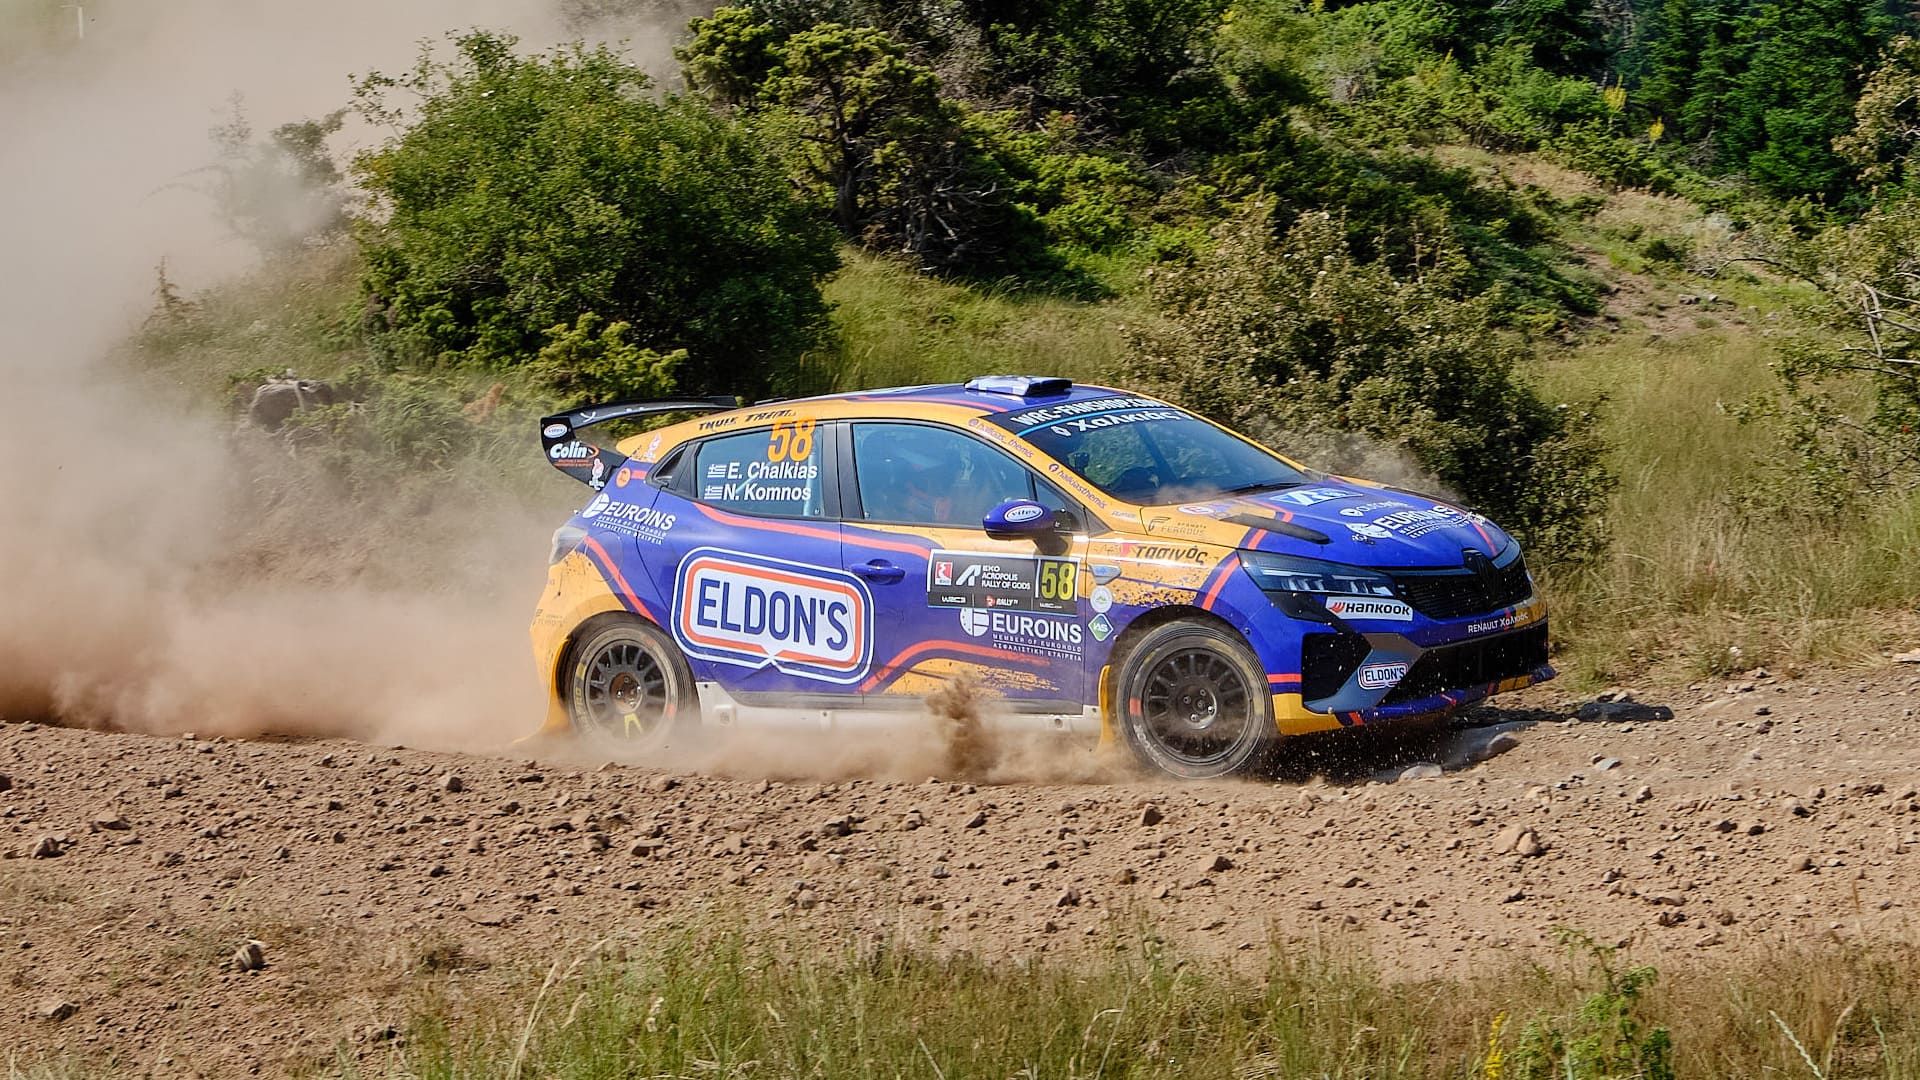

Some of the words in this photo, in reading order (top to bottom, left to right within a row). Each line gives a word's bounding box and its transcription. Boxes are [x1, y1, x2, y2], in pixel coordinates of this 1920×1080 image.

[767, 416, 816, 462] 58
[550, 441, 588, 459] Colin
[727, 462, 742, 479] E.
[747, 461, 818, 479] Chalkias
[723, 483, 739, 500] N.
[744, 483, 812, 500] Komnos
[602, 501, 676, 531] EUROINS
[981, 573, 1018, 581] ACROPOLIS
[981, 580, 1001, 589] RALLY
[1012, 582, 1031, 590] GODS
[1041, 562, 1076, 600] 58
[697, 578, 848, 651] ELDON'S
[992, 612, 1082, 644] EUROINS
[1468, 620, 1499, 634] RENAULT
[1364, 667, 1405, 682] ELDON'S
